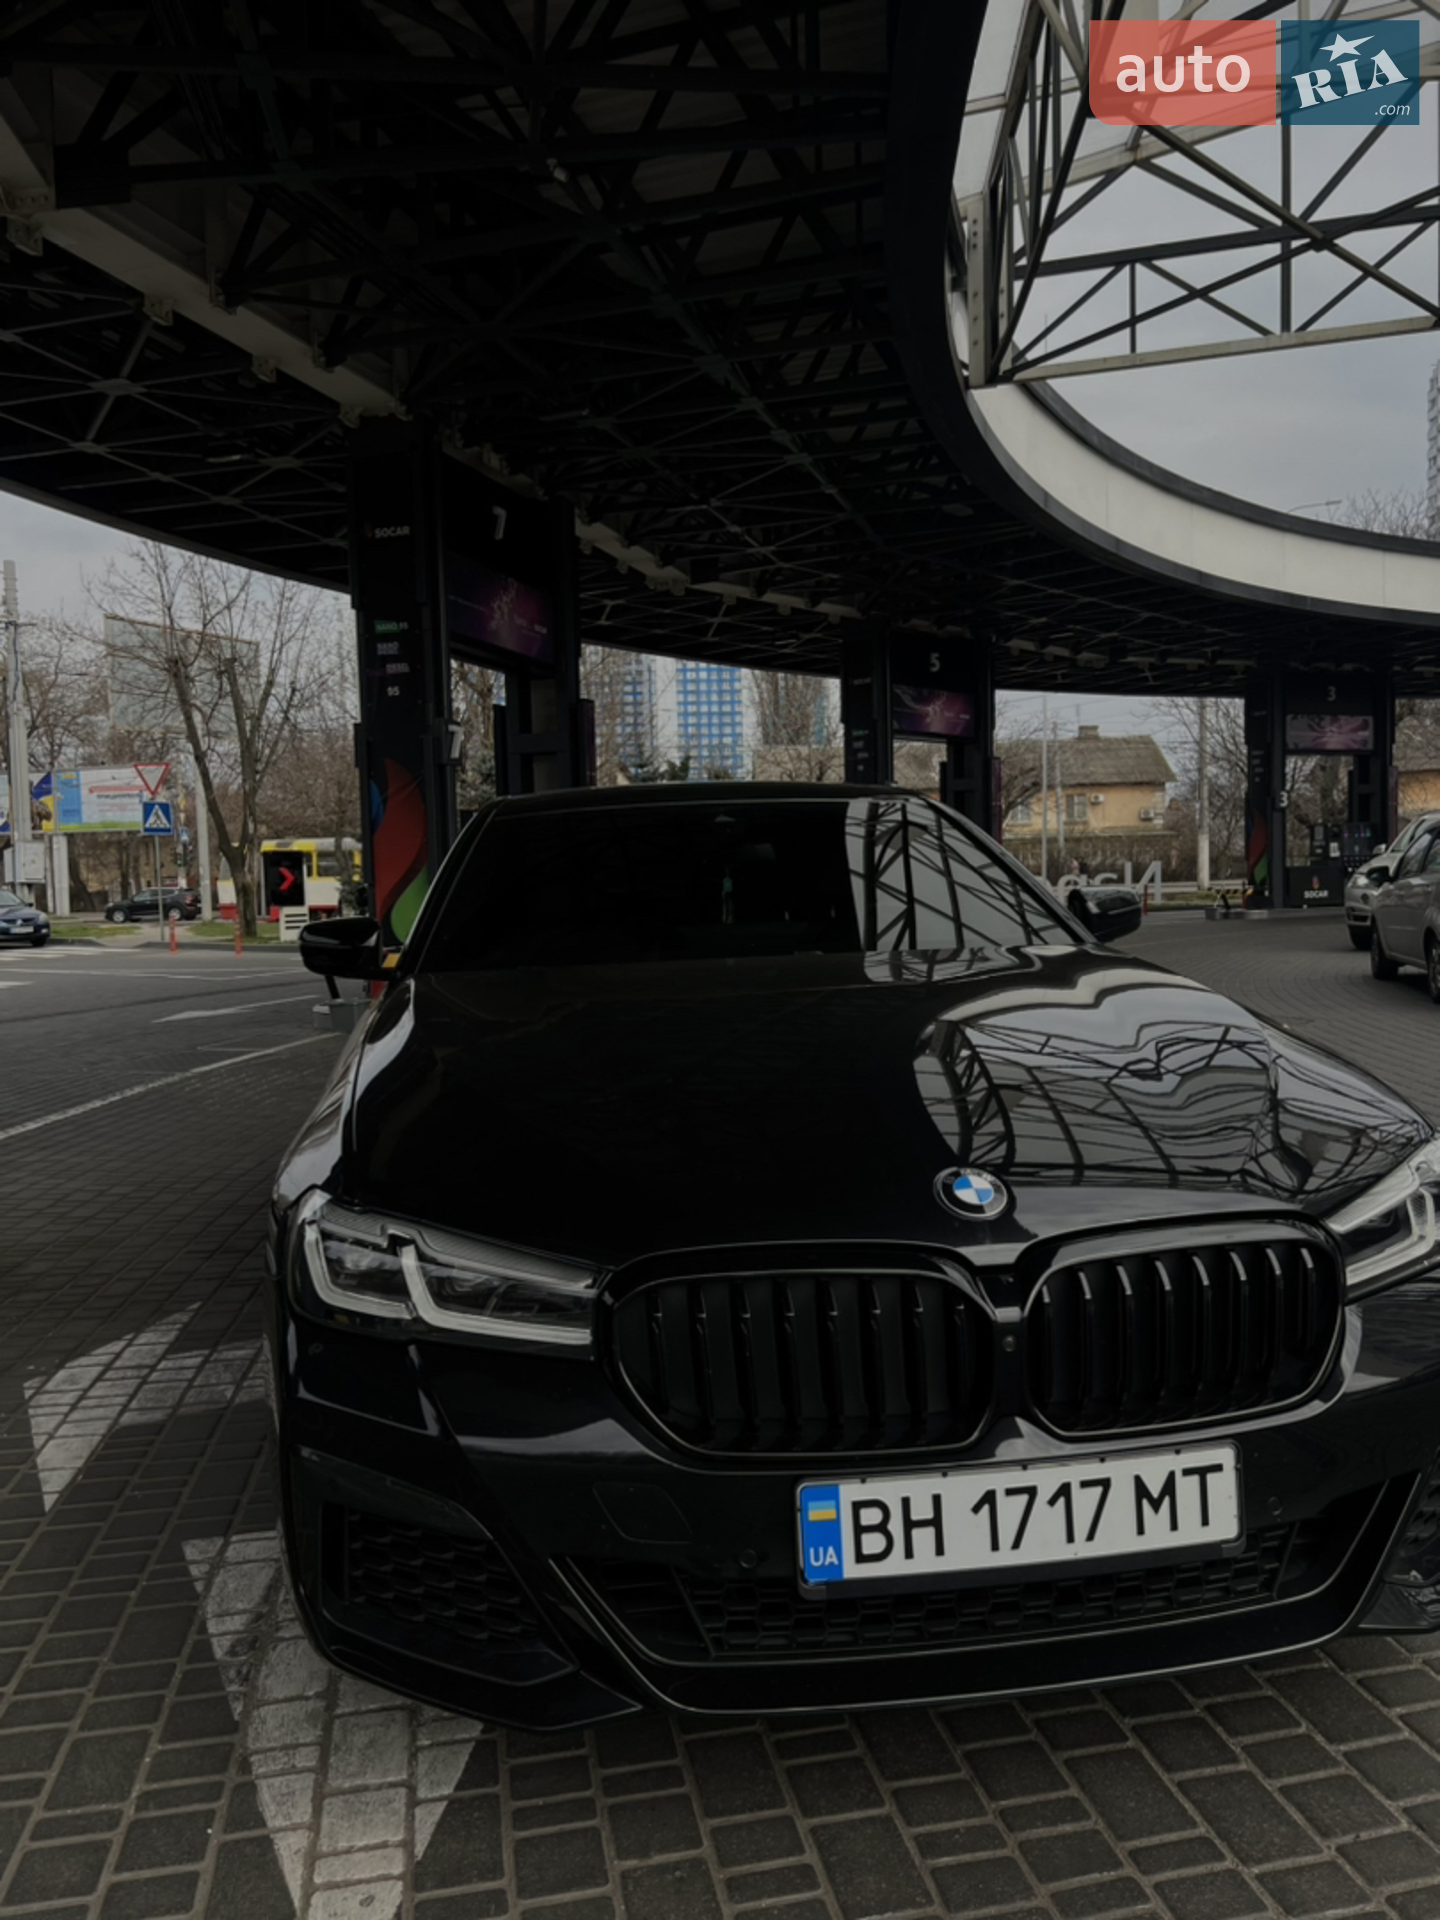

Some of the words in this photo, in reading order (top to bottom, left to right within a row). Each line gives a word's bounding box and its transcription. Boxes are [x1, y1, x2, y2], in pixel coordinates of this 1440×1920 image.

[374, 525, 411, 539] SOCAR
[491, 505, 508, 540] 7
[928, 651, 942, 673] 5
[1326, 685, 1337, 702] 3
[448, 724, 464, 759] 7
[1278, 790, 1289, 808] 3
[1303, 889, 1329, 899] SOCAR
[851, 1492, 946, 1564] BH
[971, 1477, 1112, 1552] 1717
[1133, 1463, 1224, 1537] MT
[808, 1544, 839, 1568] UA
